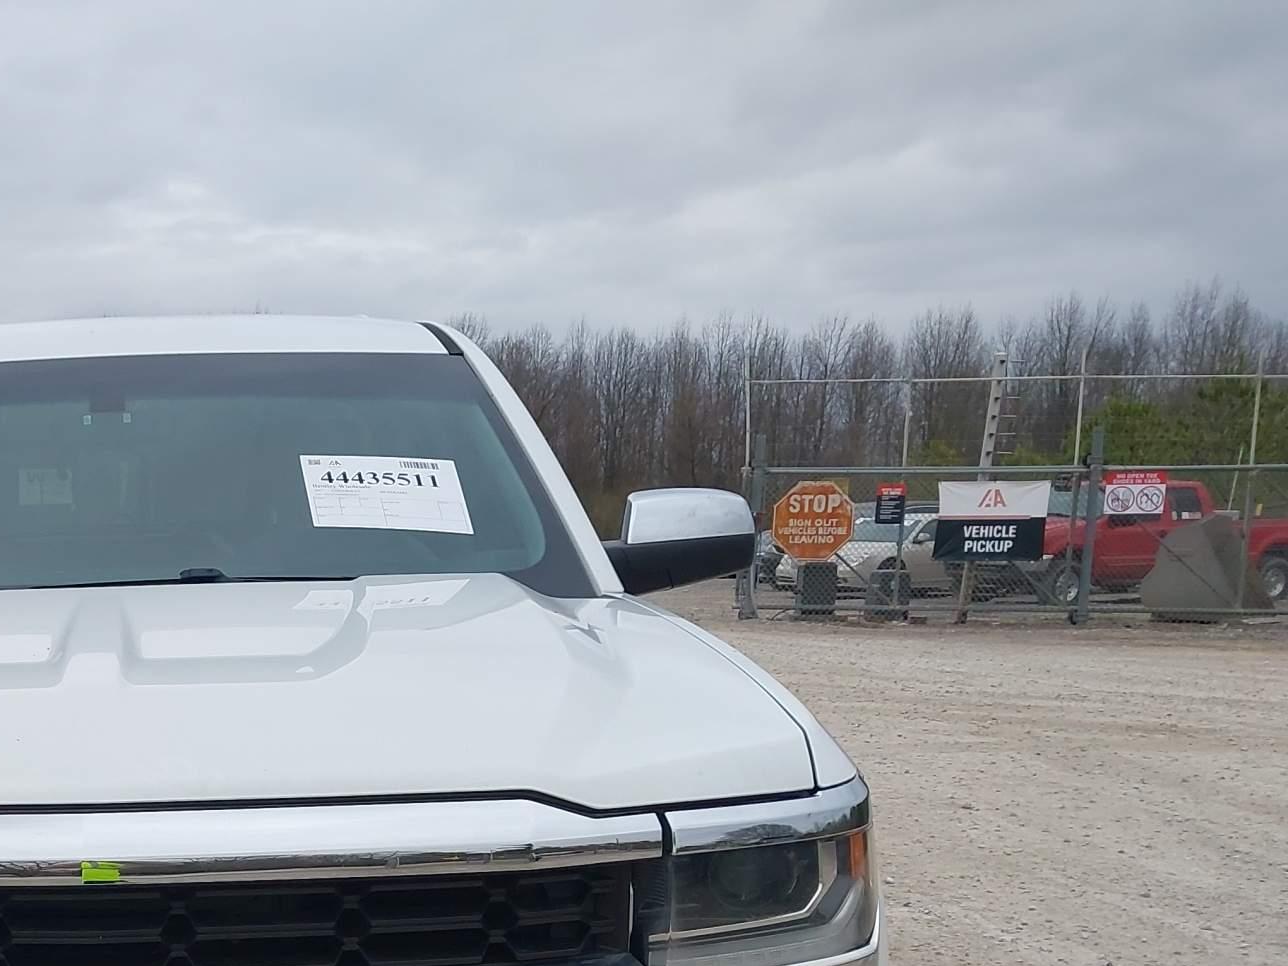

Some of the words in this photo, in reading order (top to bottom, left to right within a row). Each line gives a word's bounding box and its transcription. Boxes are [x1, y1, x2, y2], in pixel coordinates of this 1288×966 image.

[321, 471, 440, 488] 44435511
[789, 495, 841, 513] STOP
[789, 519, 812, 527] SIGN
[815, 519, 839, 527] OUT
[777, 527, 816, 535] VEHICLES
[818, 527, 849, 535] BEFORE
[963, 525, 1017, 538] VEHICLE
[789, 535, 834, 544] LEAVING
[964, 540, 1014, 553] PICKUP
